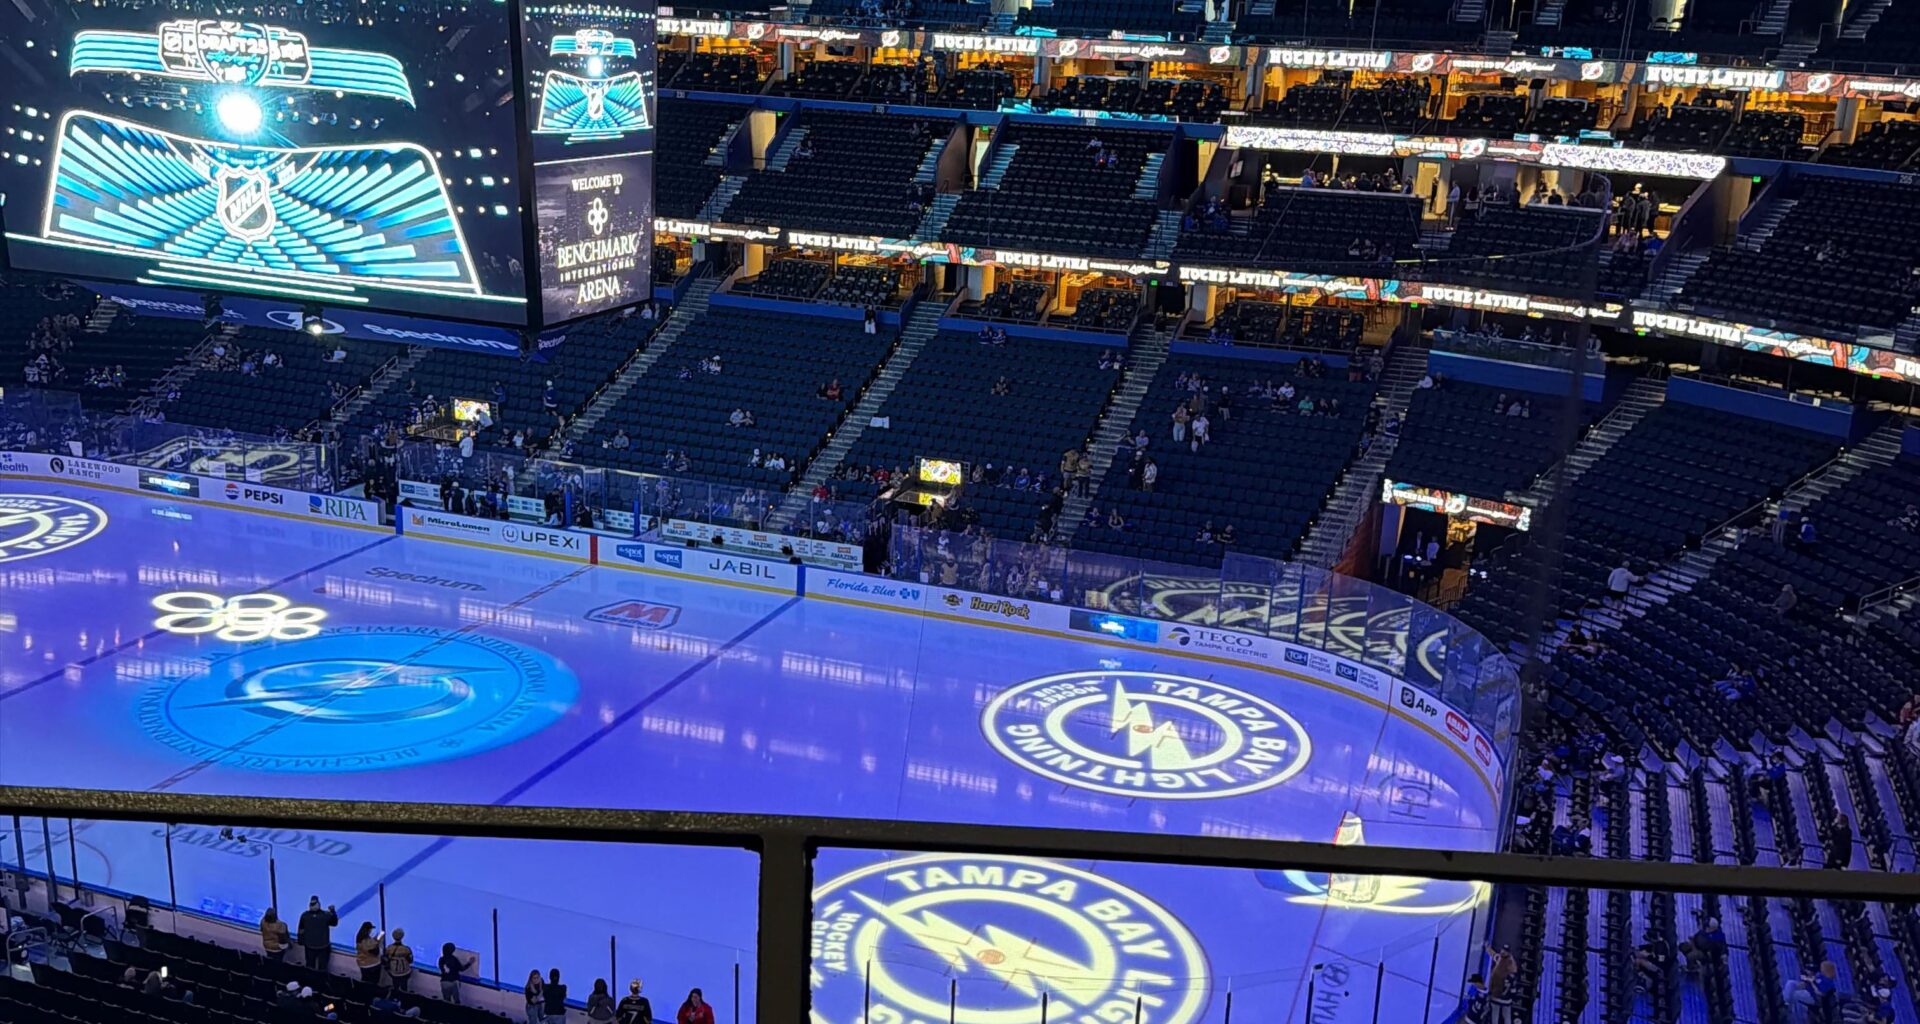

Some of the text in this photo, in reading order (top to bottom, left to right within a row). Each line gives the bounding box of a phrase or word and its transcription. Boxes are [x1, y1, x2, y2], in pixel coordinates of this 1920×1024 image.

[934, 34, 1038, 53] NOCHE LATINA
[1269, 50, 1388, 68] NOCHE LATINA
[1647, 66, 1780, 89] NOCHE LATINA
[571, 173, 623, 191] WELCOME TO
[229, 181, 262, 223] NHL
[557, 232, 638, 269] BENCHMARK
[995, 250, 1039, 266] NOCHE
[1041, 254, 1089, 271] LATINA
[560, 257, 635, 282] INTERNATIONAL
[1179, 267, 1227, 282] NOCHE
[1228, 270, 1280, 287] LATINA
[577, 275, 621, 304] ARENA
[1422, 286, 1473, 303] NOCHE
[1474, 290, 1528, 311] LATINA
[363, 323, 518, 351] Spectrum
[1632, 310, 1741, 343] NOCHE LATINA
[537, 334, 566, 351] Spectrum
[68, 459, 121, 474] LAKEWOOD
[68, 467, 101, 479] RANCH
[244, 489, 284, 505] PEPSI
[325, 497, 368, 521] RIPA
[427, 516, 490, 532] MicroLumen
[521, 531, 580, 550] UPEXI
[625, 546, 642, 558] spot
[663, 552, 680, 563] spot
[366, 566, 487, 592] Spectrum
[709, 557, 776, 580] JABIL
[827, 578, 897, 598] Florida Blue
[970, 597, 1000, 612] Hard
[1000, 601, 1030, 620] Rock
[1195, 629, 1253, 648] TECO
[1193, 641, 1268, 659] TAMPA ELECTRIC
[1290, 651, 1307, 662] TGH
[318, 626, 547, 732] NCHMARK INTERNATIONAL ARENA
[1340, 664, 1357, 679] TGH
[1031, 682, 1076, 698] CLUB
[1037, 686, 1102, 709] HOCKEY
[1415, 698, 1438, 717] App
[1006, 680, 1288, 789] TAMPA BAY LIGHTNING
[233, 747, 421, 768] BENCHMARK
[151, 825, 268, 858] JAMES
[885, 864, 1078, 903] TAMPA
[1082, 898, 1172, 960] BAY
[823, 912, 863, 972] HOCKEY
